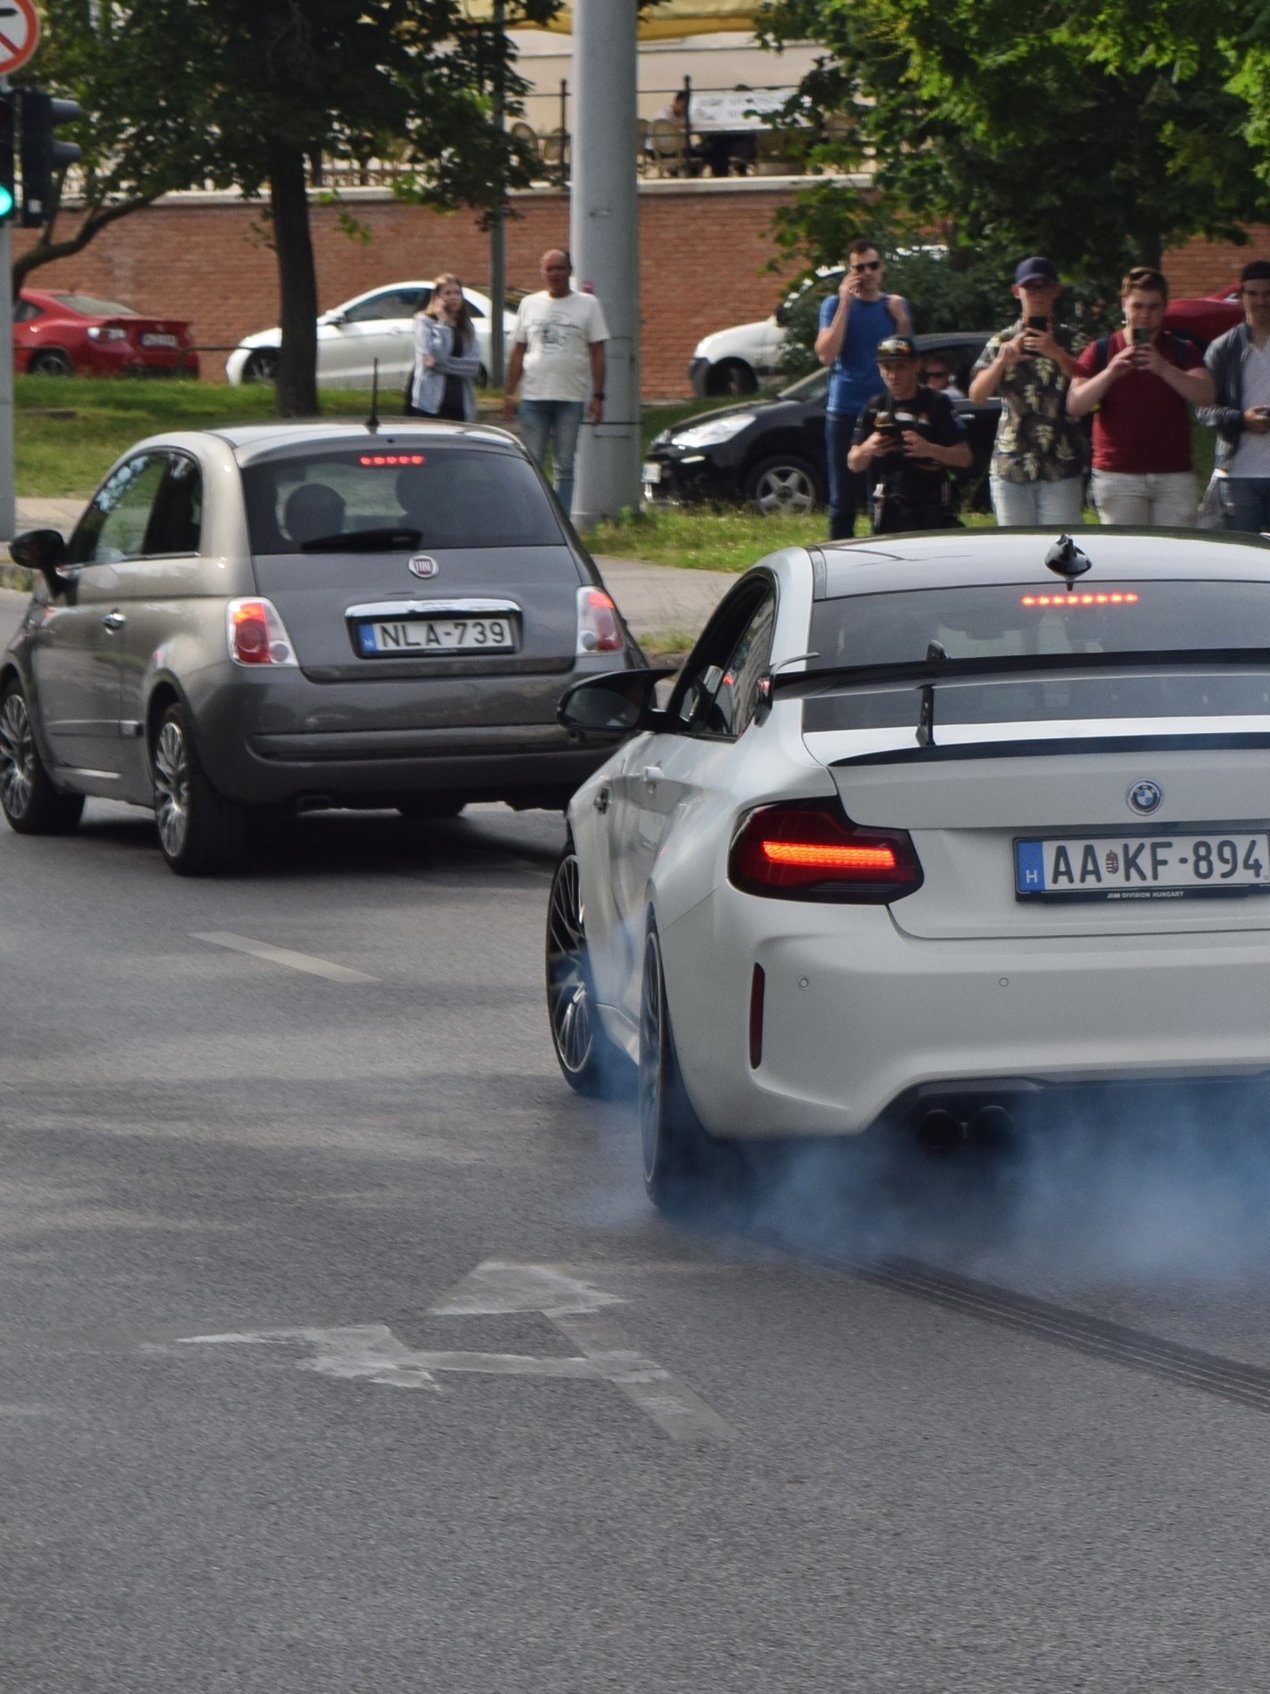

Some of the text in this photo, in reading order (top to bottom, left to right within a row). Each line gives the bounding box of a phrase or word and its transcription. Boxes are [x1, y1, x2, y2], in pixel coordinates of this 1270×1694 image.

[379, 621, 505, 647] NLA-739
[365, 639, 373, 648] H
[1025, 869, 1038, 884] H
